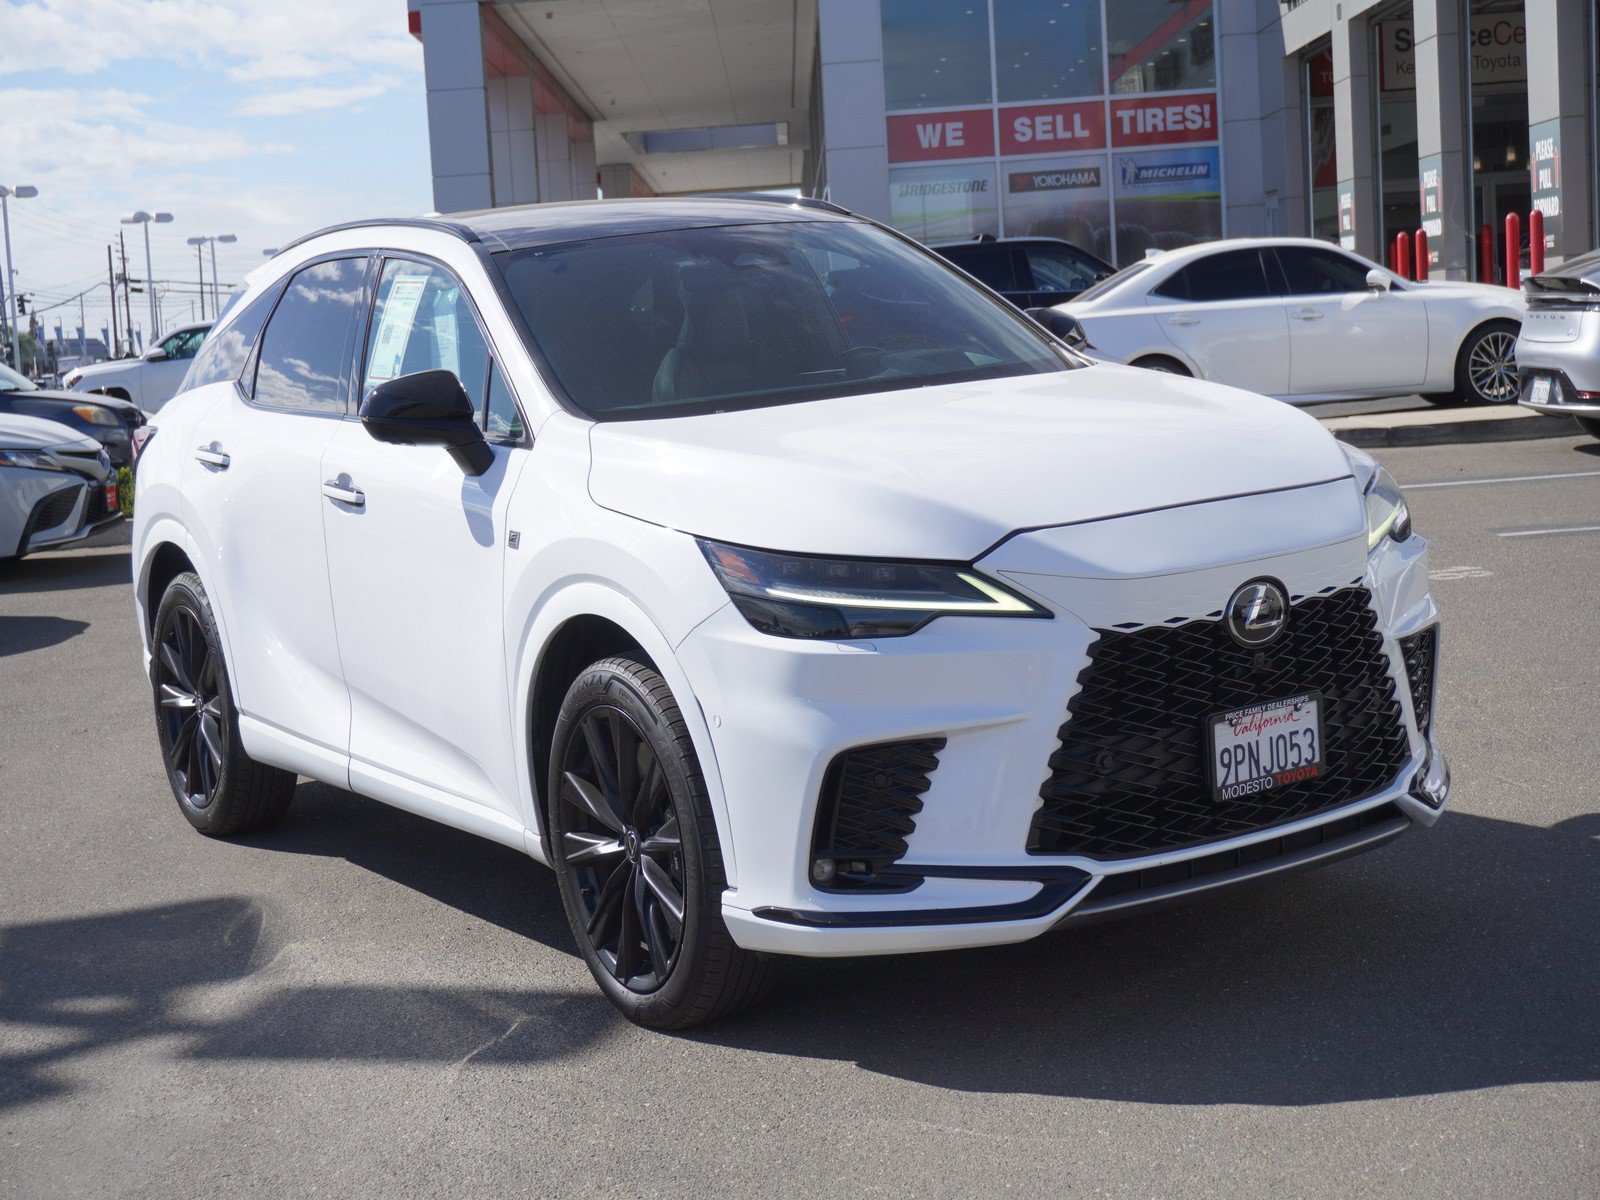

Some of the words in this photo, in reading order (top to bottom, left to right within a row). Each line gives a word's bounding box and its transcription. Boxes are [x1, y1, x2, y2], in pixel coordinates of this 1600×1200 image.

[1473, 53, 1521, 72] Toyota
[915, 121, 964, 149] WE
[1012, 113, 1090, 143] SELL
[1117, 105, 1213, 134] TIRES!
[1535, 138, 1554, 162] PLEASE
[1033, 171, 1096, 187] YOKOHAMA
[1139, 164, 1208, 179] MICHELIN
[1539, 168, 1552, 190] PULL
[899, 179, 988, 198] BRIDGESTONE
[1225, 710, 1243, 721] PRICE
[1245, 705, 1266, 717] FAMILY
[1267, 695, 1309, 711] DEALERSHIPS
[1233, 708, 1301, 737] California
[1220, 727, 1315, 787] 9PNJ053
[1222, 776, 1273, 800] MODESTO
[1276, 766, 1318, 784] TOYOTA
